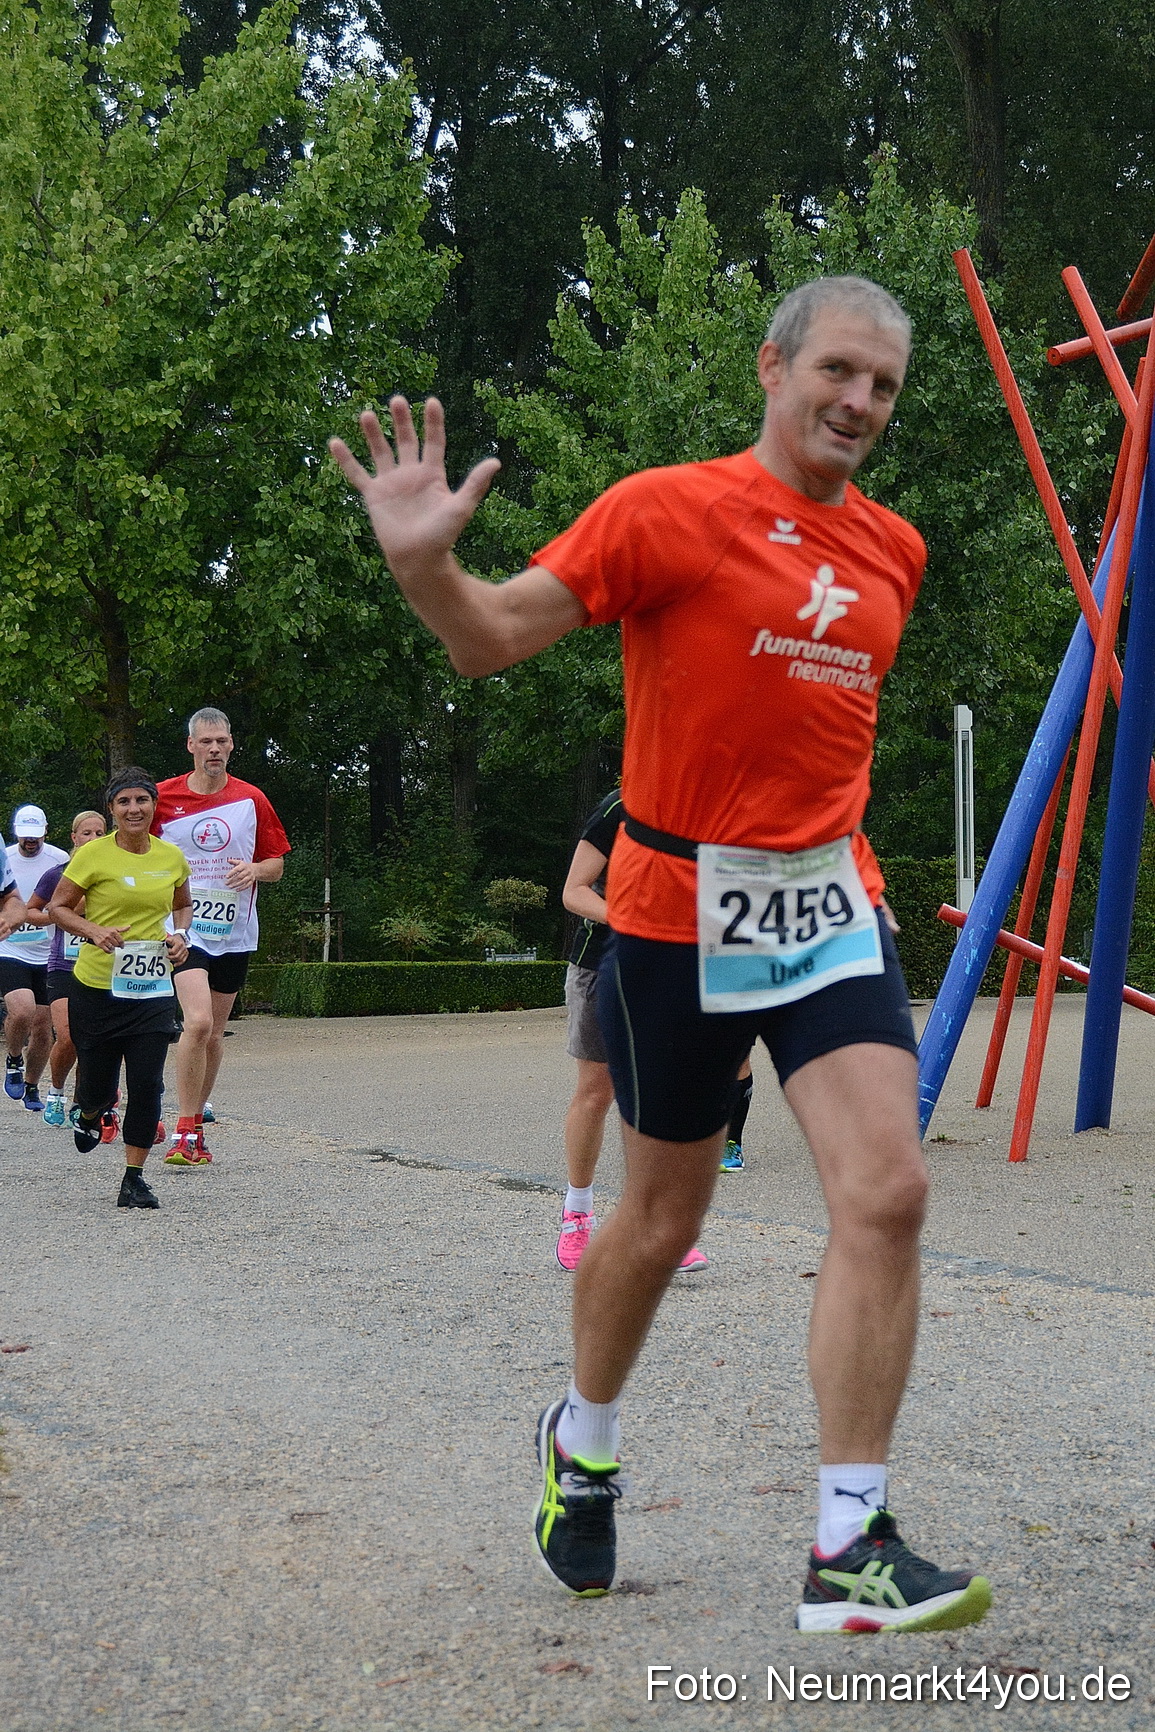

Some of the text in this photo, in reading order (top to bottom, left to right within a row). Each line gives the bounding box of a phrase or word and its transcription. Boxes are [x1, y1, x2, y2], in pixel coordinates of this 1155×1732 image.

[750, 628, 872, 671] funrunners
[192, 899, 236, 922] 2226
[719, 883, 854, 945] 2459
[196, 923, 226, 935] Rüdiger
[120, 953, 166, 977] 2545
[769, 956, 815, 986] Uwe
